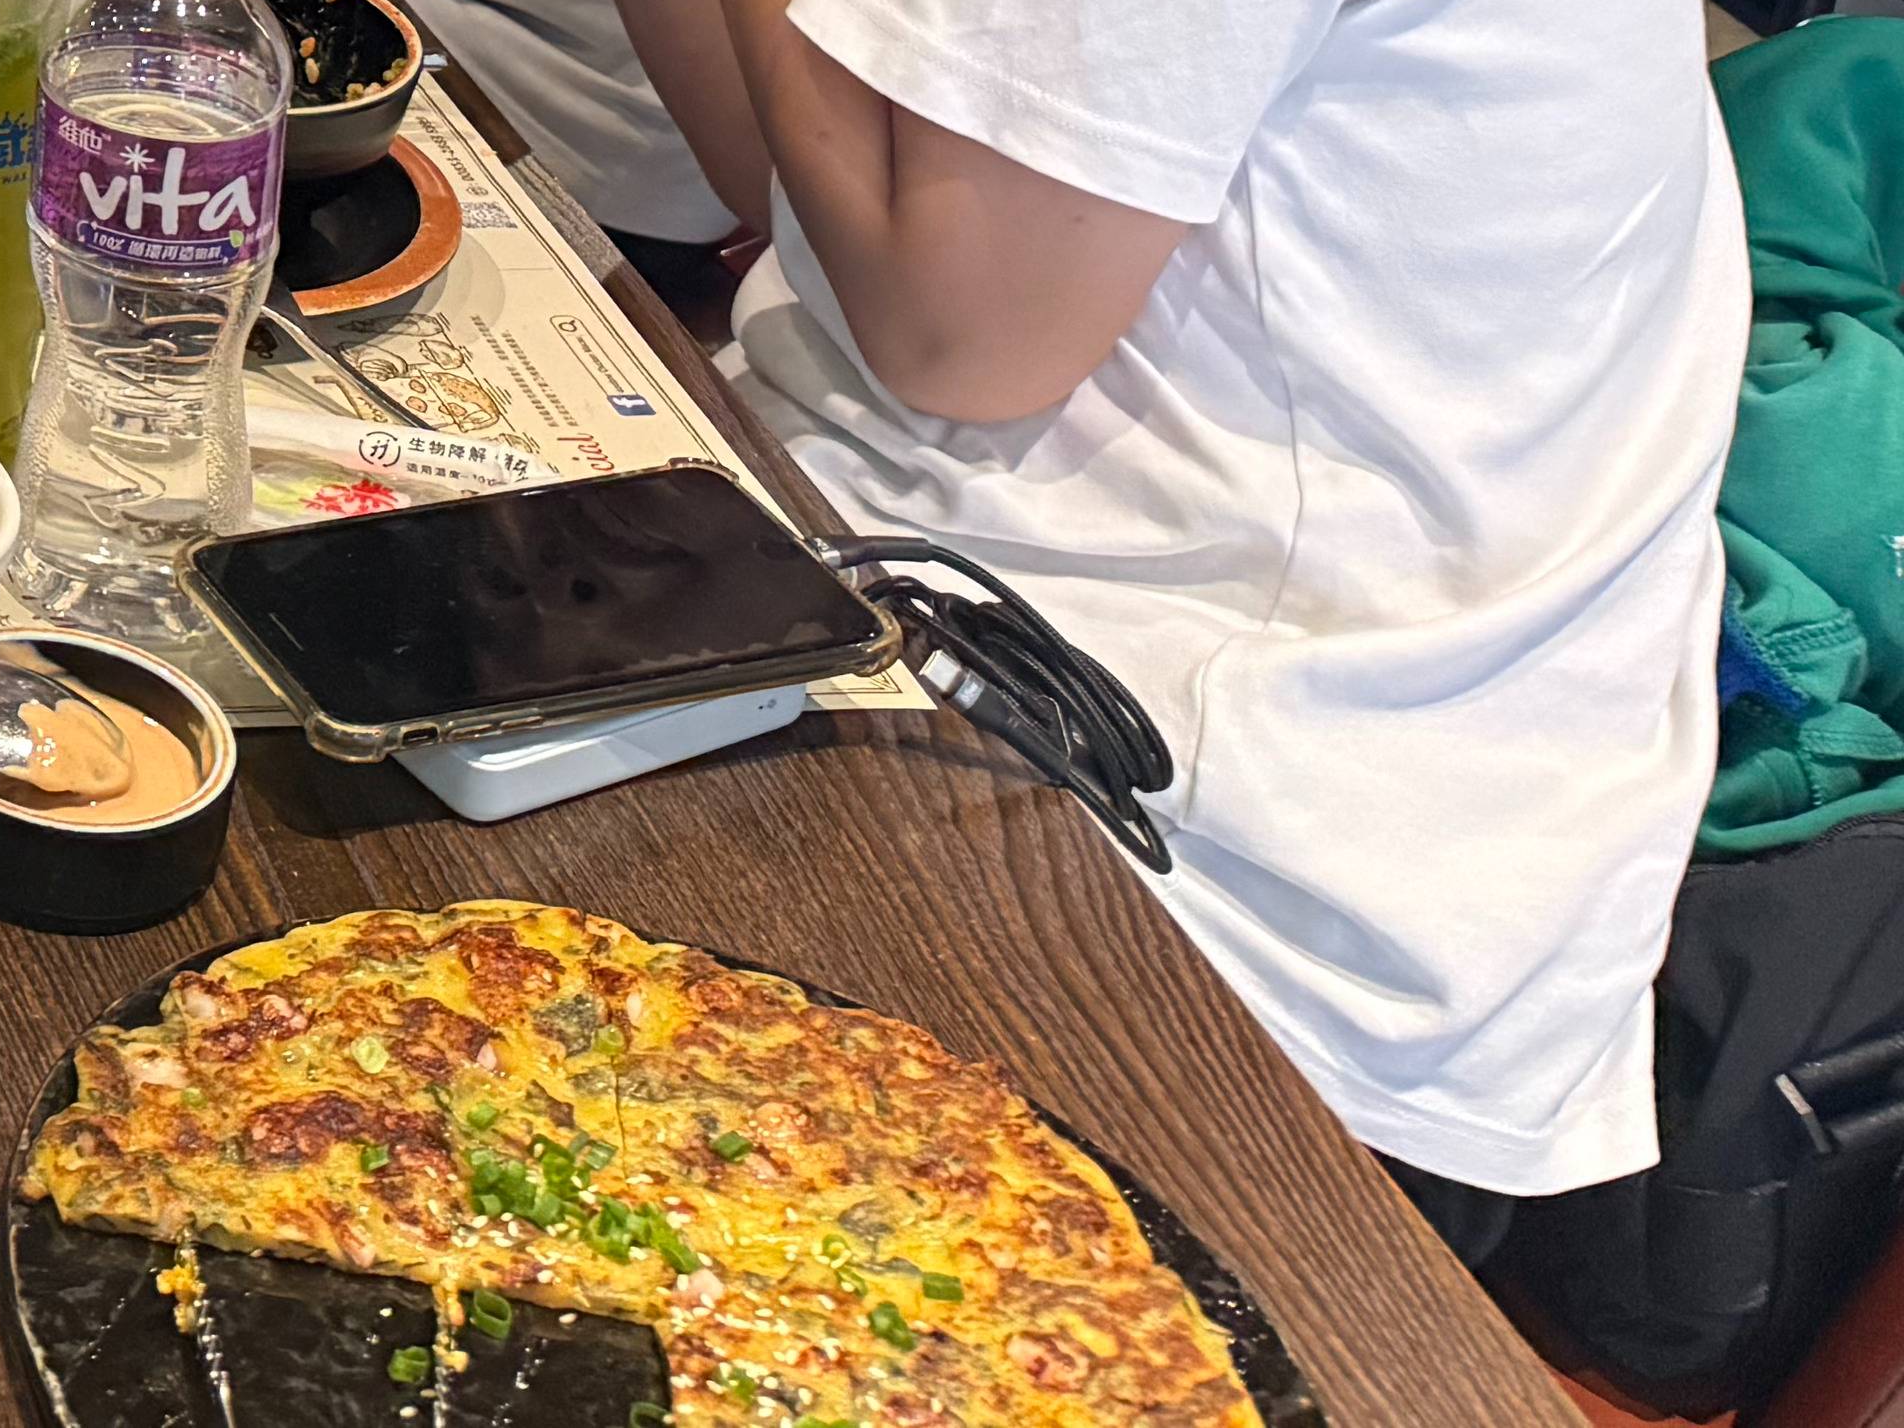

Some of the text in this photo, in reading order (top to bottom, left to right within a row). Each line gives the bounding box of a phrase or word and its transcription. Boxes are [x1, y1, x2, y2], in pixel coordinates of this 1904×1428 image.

[79, 144, 257, 235] vita
[407, 436, 488, 465] 生物降解
